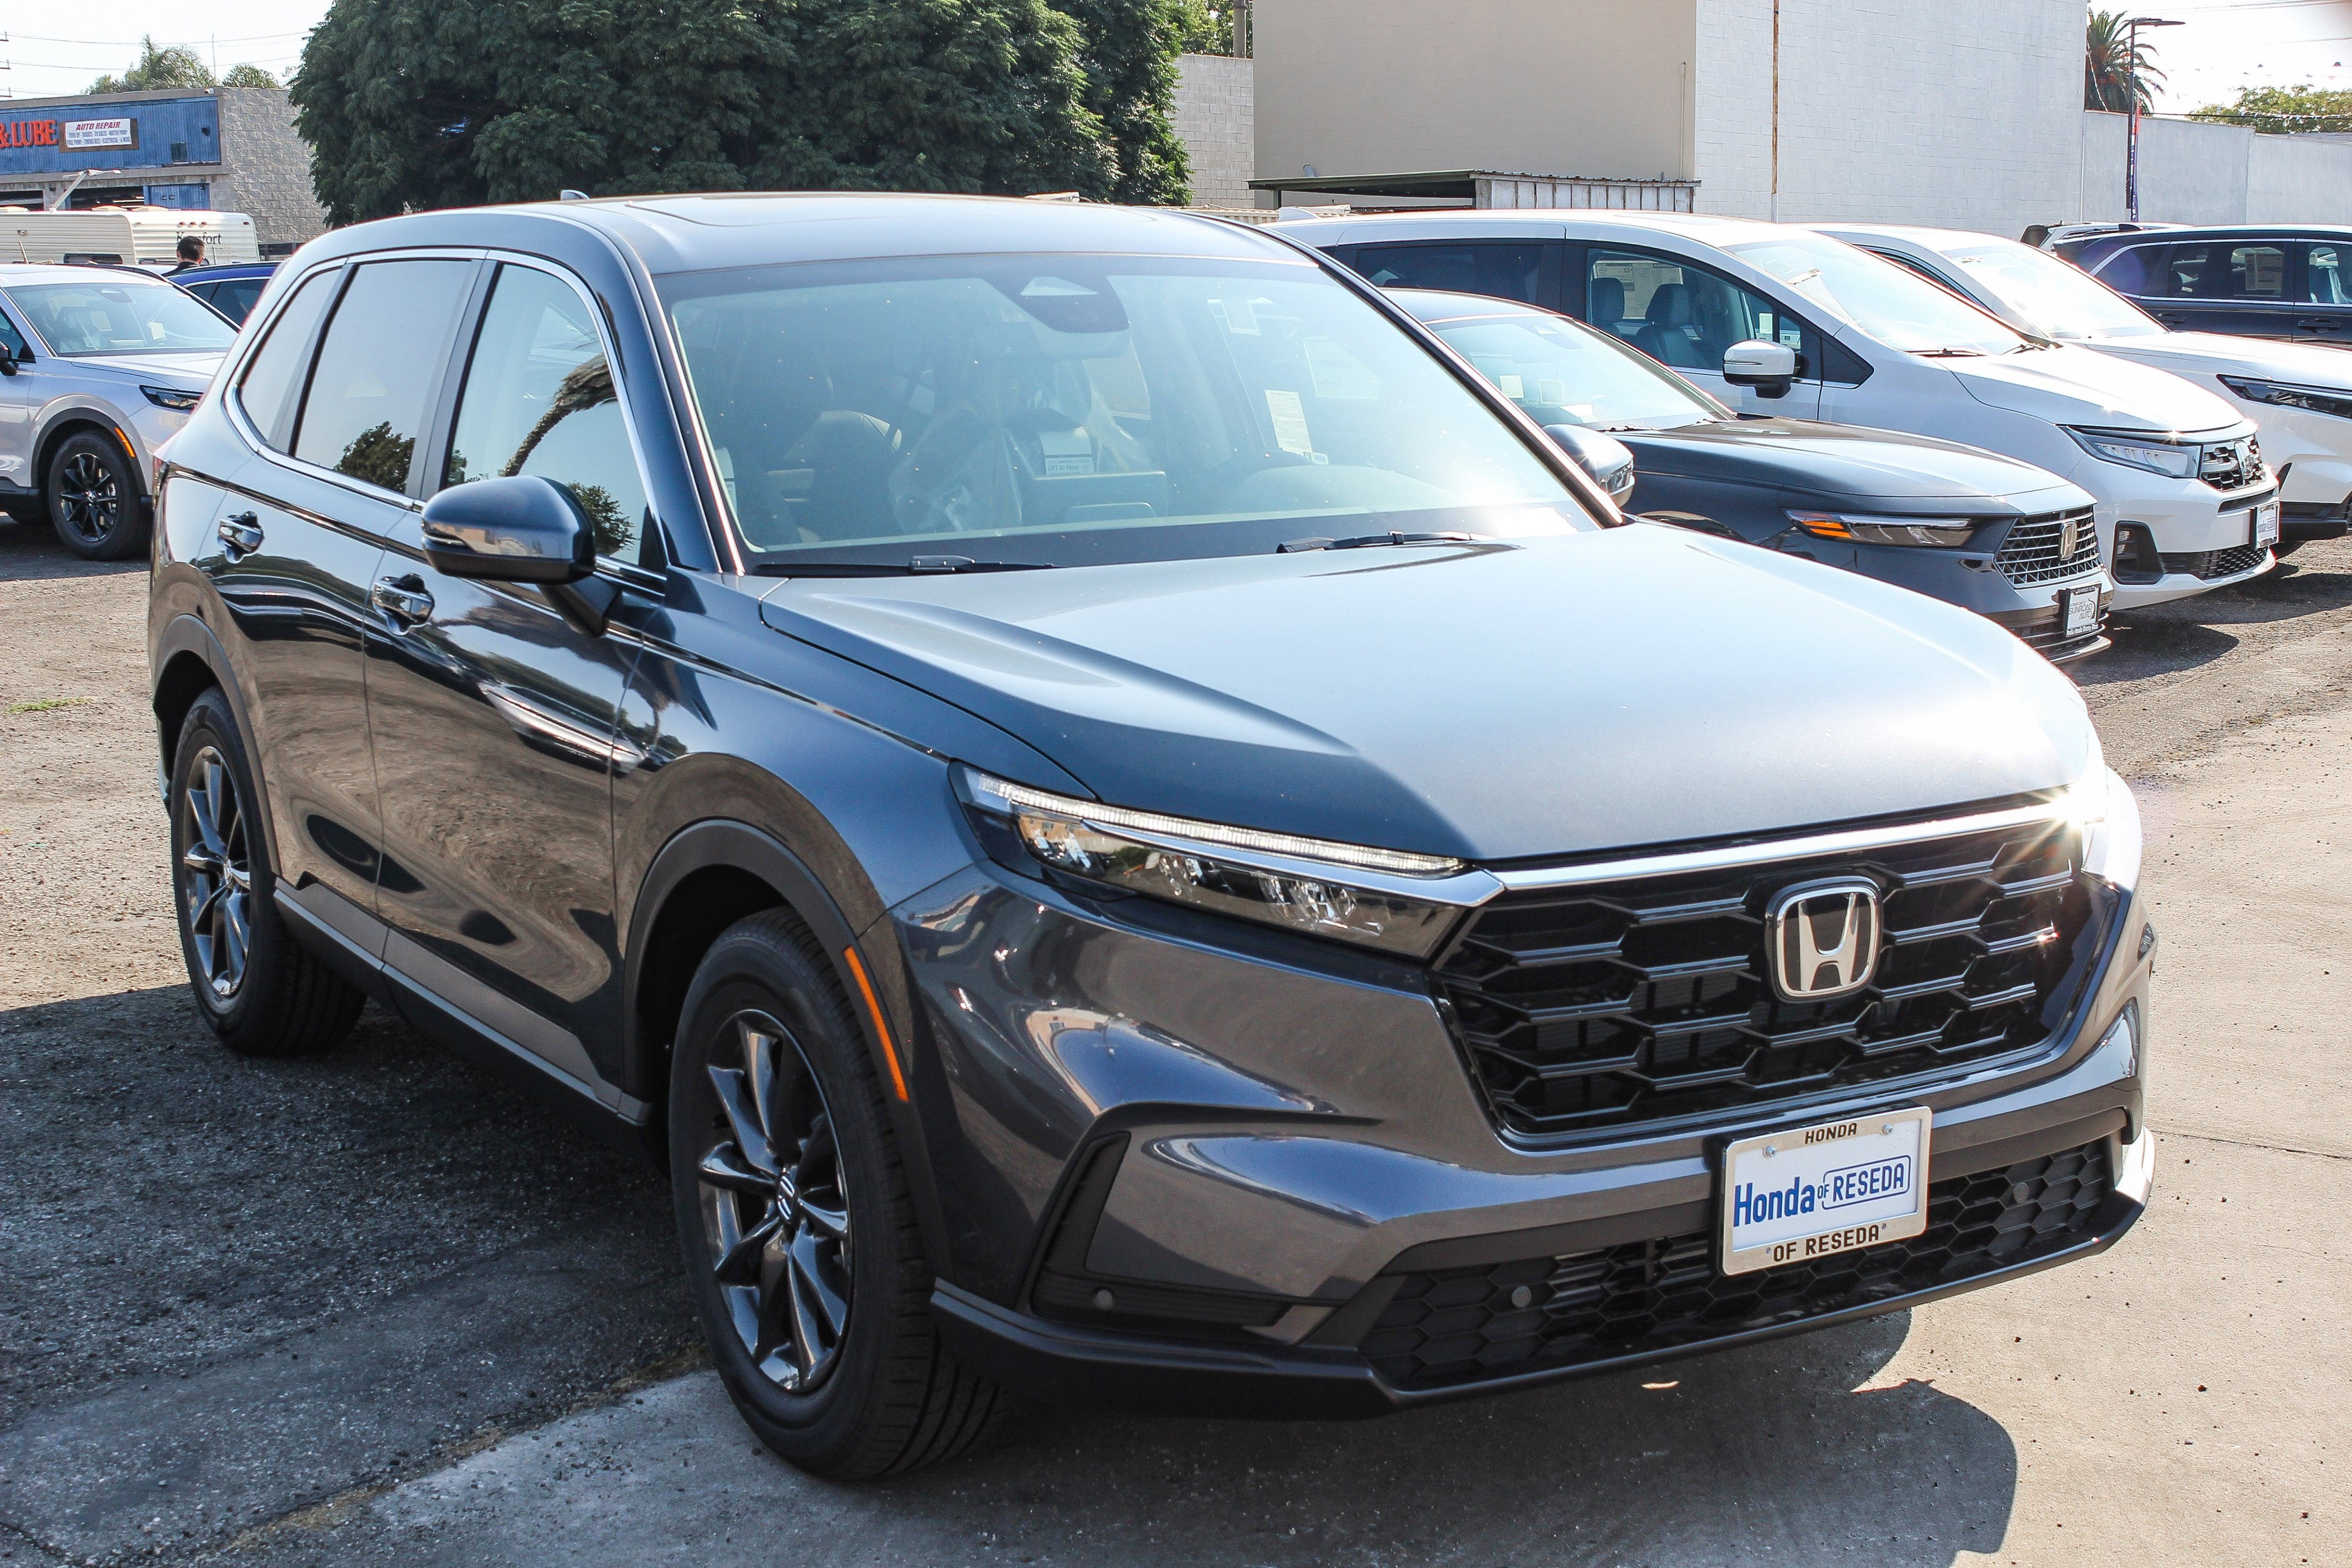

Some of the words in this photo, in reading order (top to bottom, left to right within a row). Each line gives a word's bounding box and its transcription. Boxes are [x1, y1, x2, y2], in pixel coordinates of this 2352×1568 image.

[11, 119, 58, 147] LUBE
[176, 231, 222, 245] Kfort
[2068, 603, 2093, 615] SUNROAD
[2079, 610, 2092, 620] AUTO
[1804, 1122, 1857, 1145] HONDA
[1733, 1176, 1815, 1228] Honda
[1817, 1183, 1830, 1200] OF
[1833, 1162, 1904, 1202] RESEDA
[1772, 1244, 1797, 1263] OF
[1805, 1224, 1879, 1256] RESEDA
